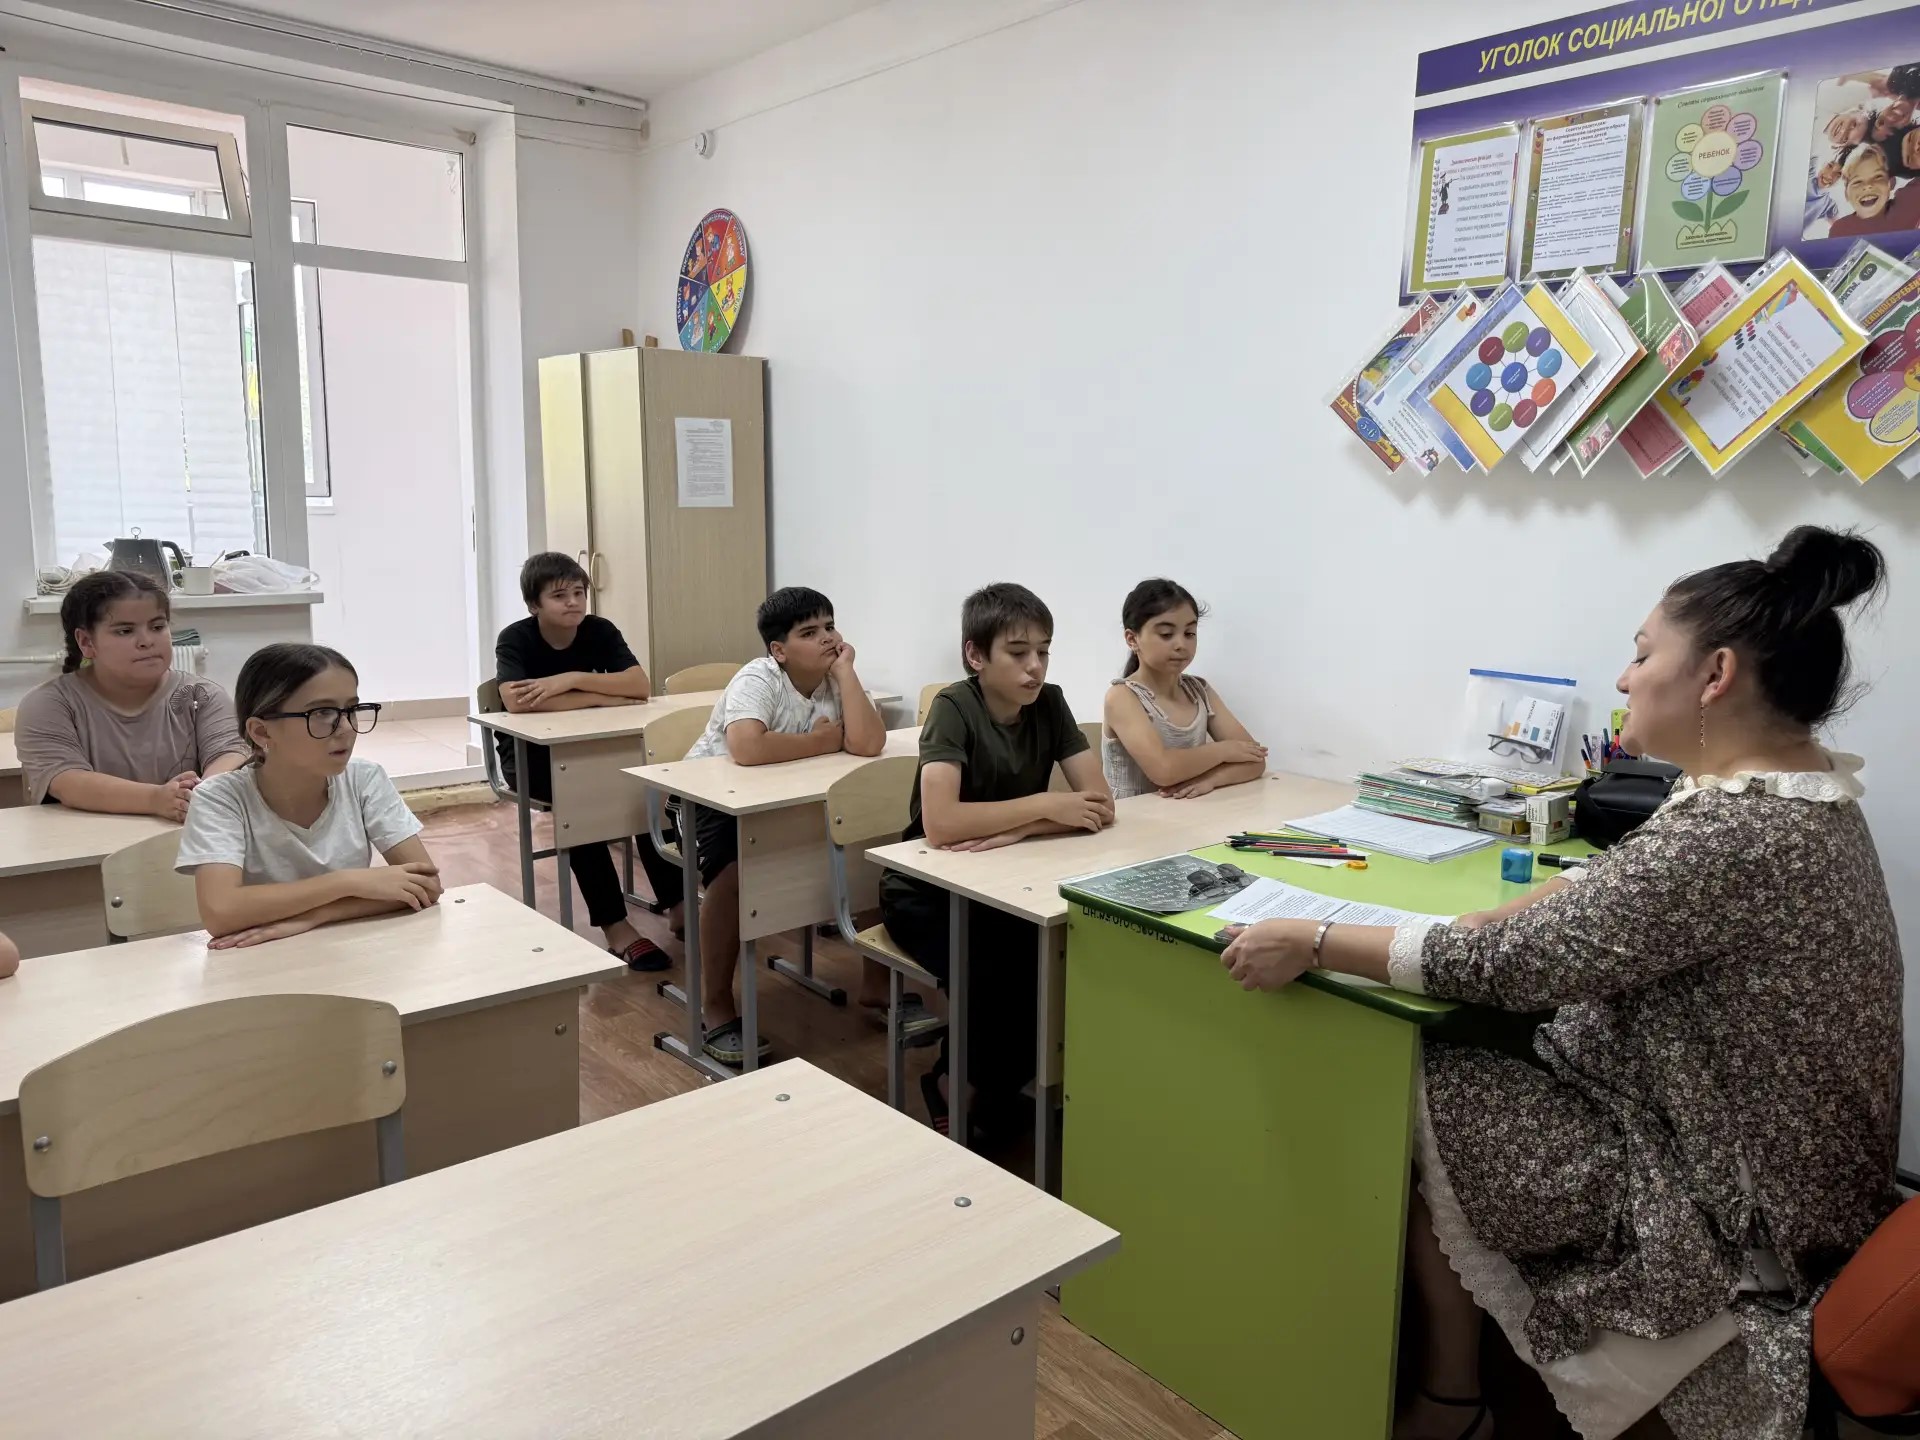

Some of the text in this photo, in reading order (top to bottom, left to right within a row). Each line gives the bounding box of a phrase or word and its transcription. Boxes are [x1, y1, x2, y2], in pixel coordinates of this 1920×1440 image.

[1478, 32, 1564, 73] УГОЛОК
[1698, 148, 1730, 160] РЕБЕНОК
[1359, 420, 1377, 438] 5-6
